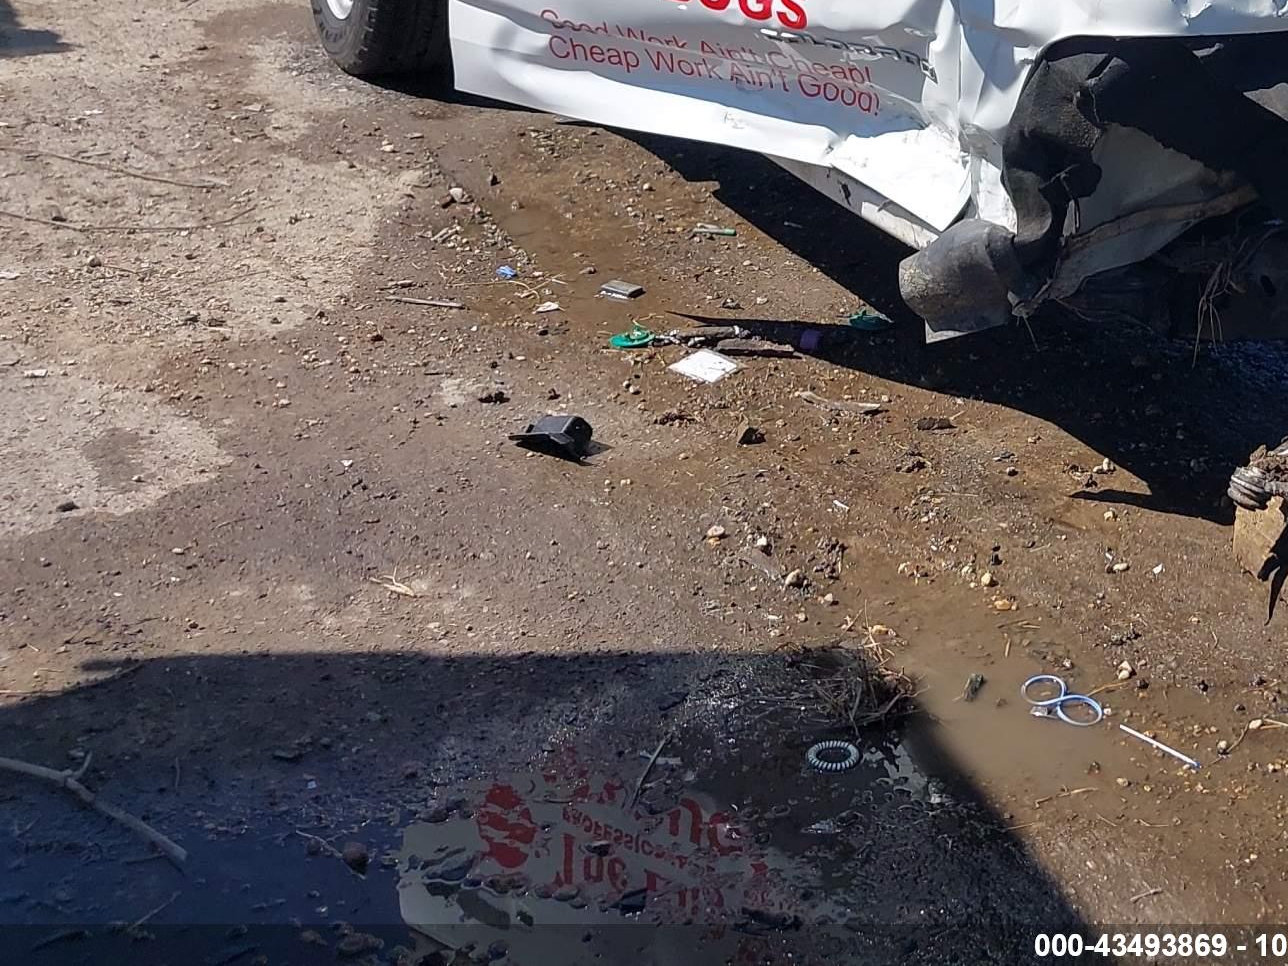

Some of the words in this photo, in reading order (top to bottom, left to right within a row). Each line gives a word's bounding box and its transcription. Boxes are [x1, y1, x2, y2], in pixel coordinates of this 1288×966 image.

[549, 35, 640, 74] Cheap
[646, 47, 723, 80] Work
[729, 61, 789, 92] Ain't
[799, 74, 881, 116] Good!
